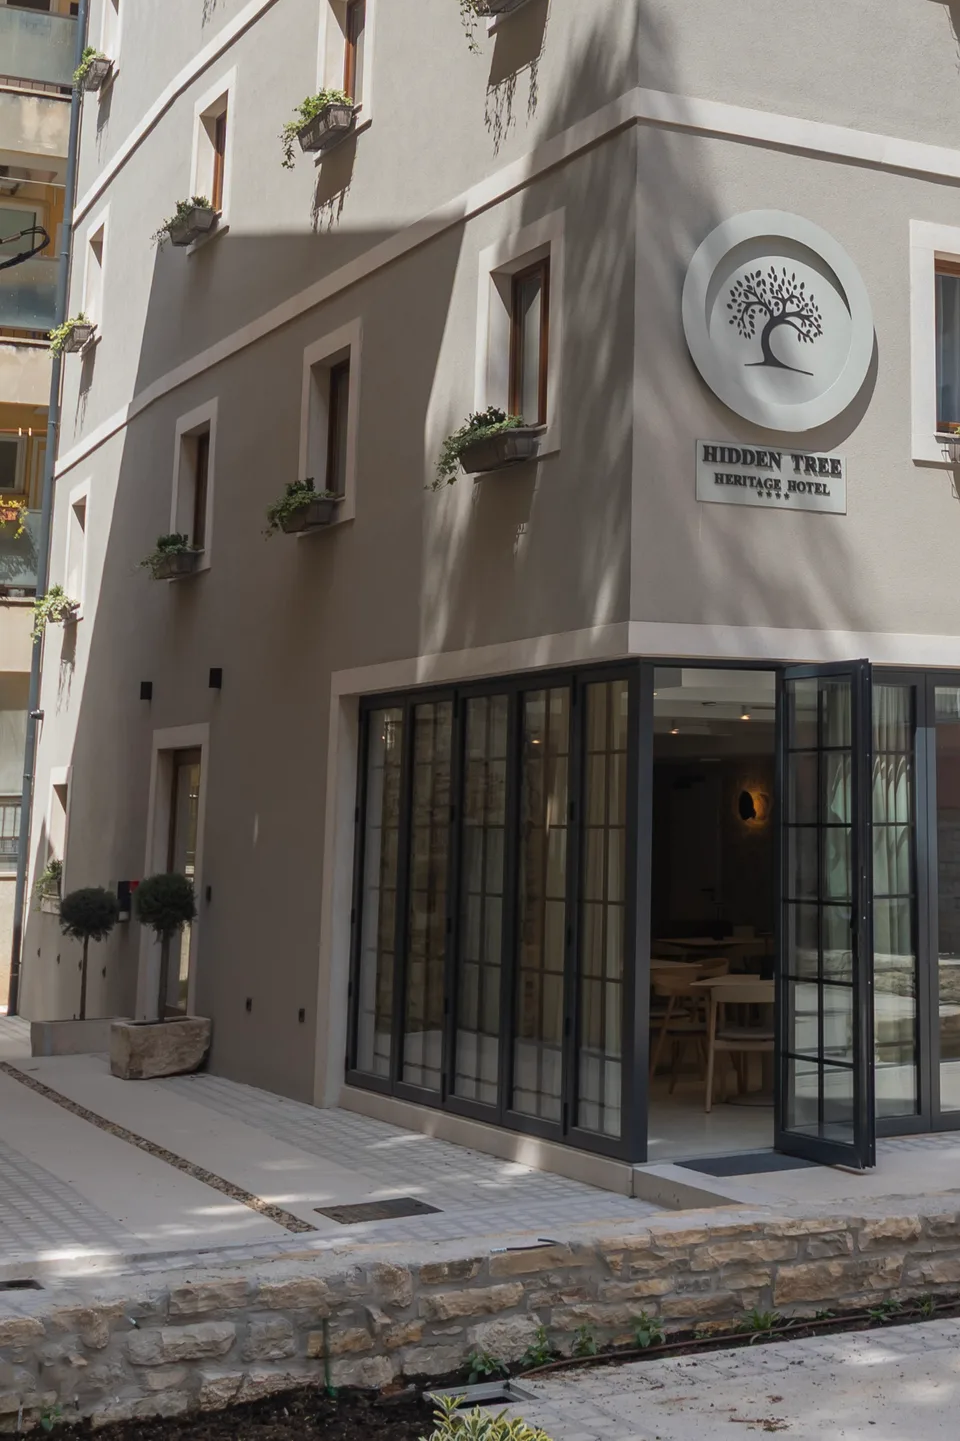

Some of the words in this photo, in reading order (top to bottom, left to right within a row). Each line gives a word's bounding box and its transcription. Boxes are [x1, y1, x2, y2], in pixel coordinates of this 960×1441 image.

[702, 445, 783, 471] HIDDEN
[791, 454, 842, 477] TREE
[714, 472, 781, 490] HERITAGE
[787, 480, 831, 496] HOTEL
